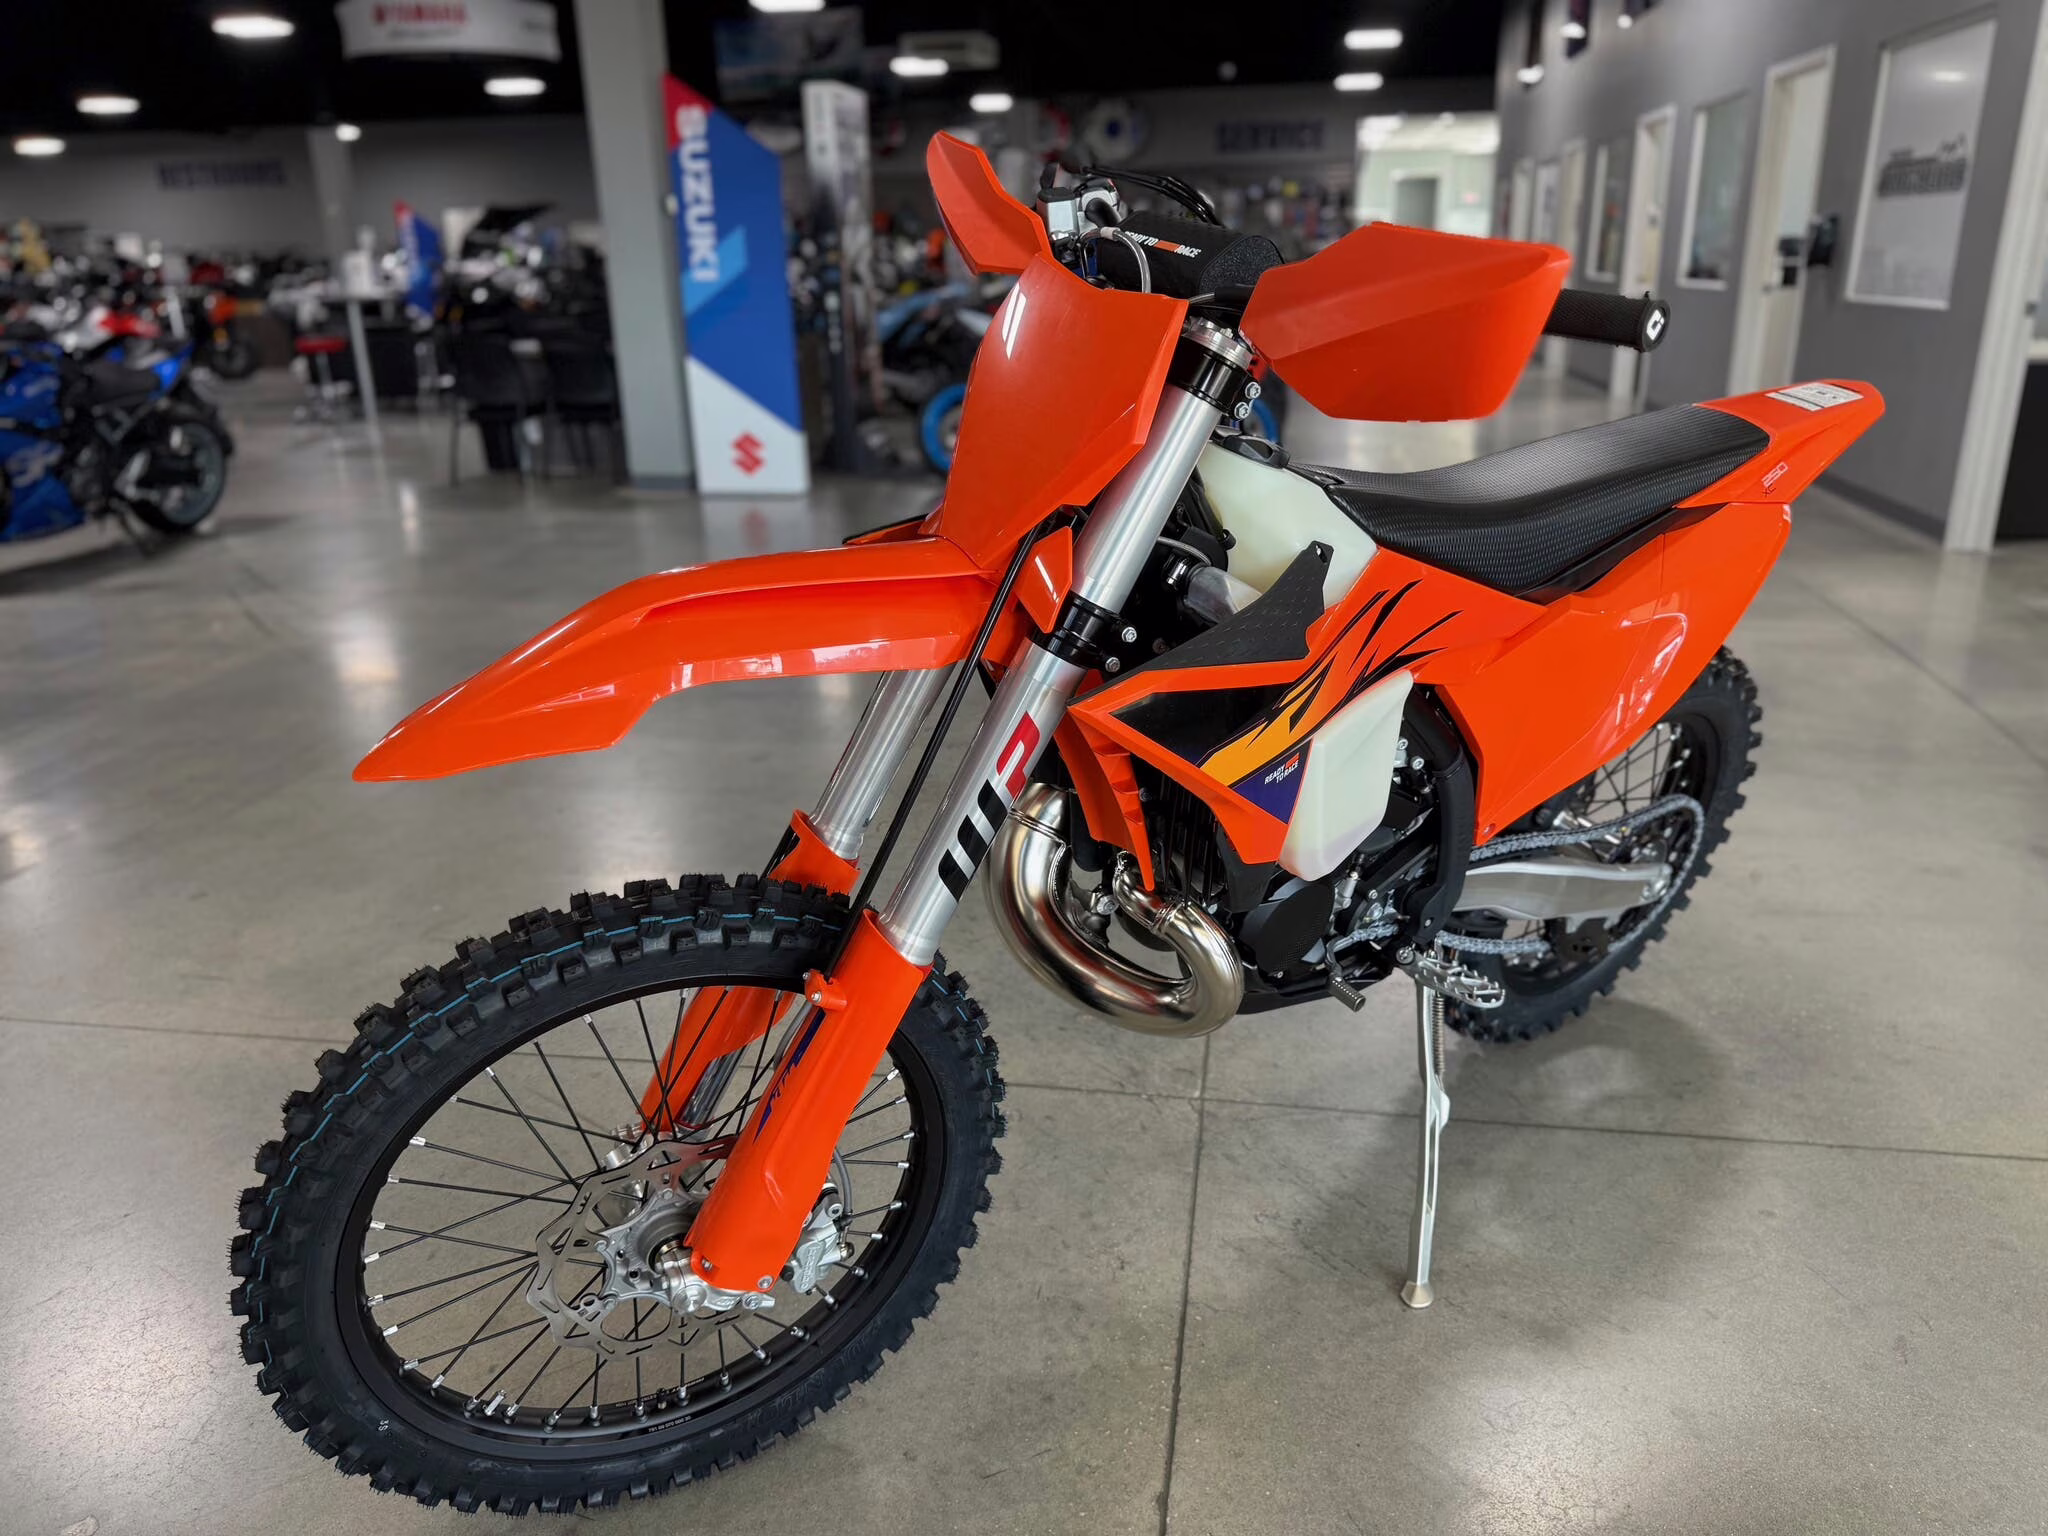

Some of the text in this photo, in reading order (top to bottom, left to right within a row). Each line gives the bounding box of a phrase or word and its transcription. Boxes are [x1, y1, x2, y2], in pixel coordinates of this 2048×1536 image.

[676, 103, 720, 283] SUZUKI
[1144, 236, 1159, 247] TO
[1174, 244, 1202, 259] RACE
[1761, 461, 1789, 488] 250
[1264, 764, 1286, 785] READY
[1276, 759, 1299, 784] TO RACE
